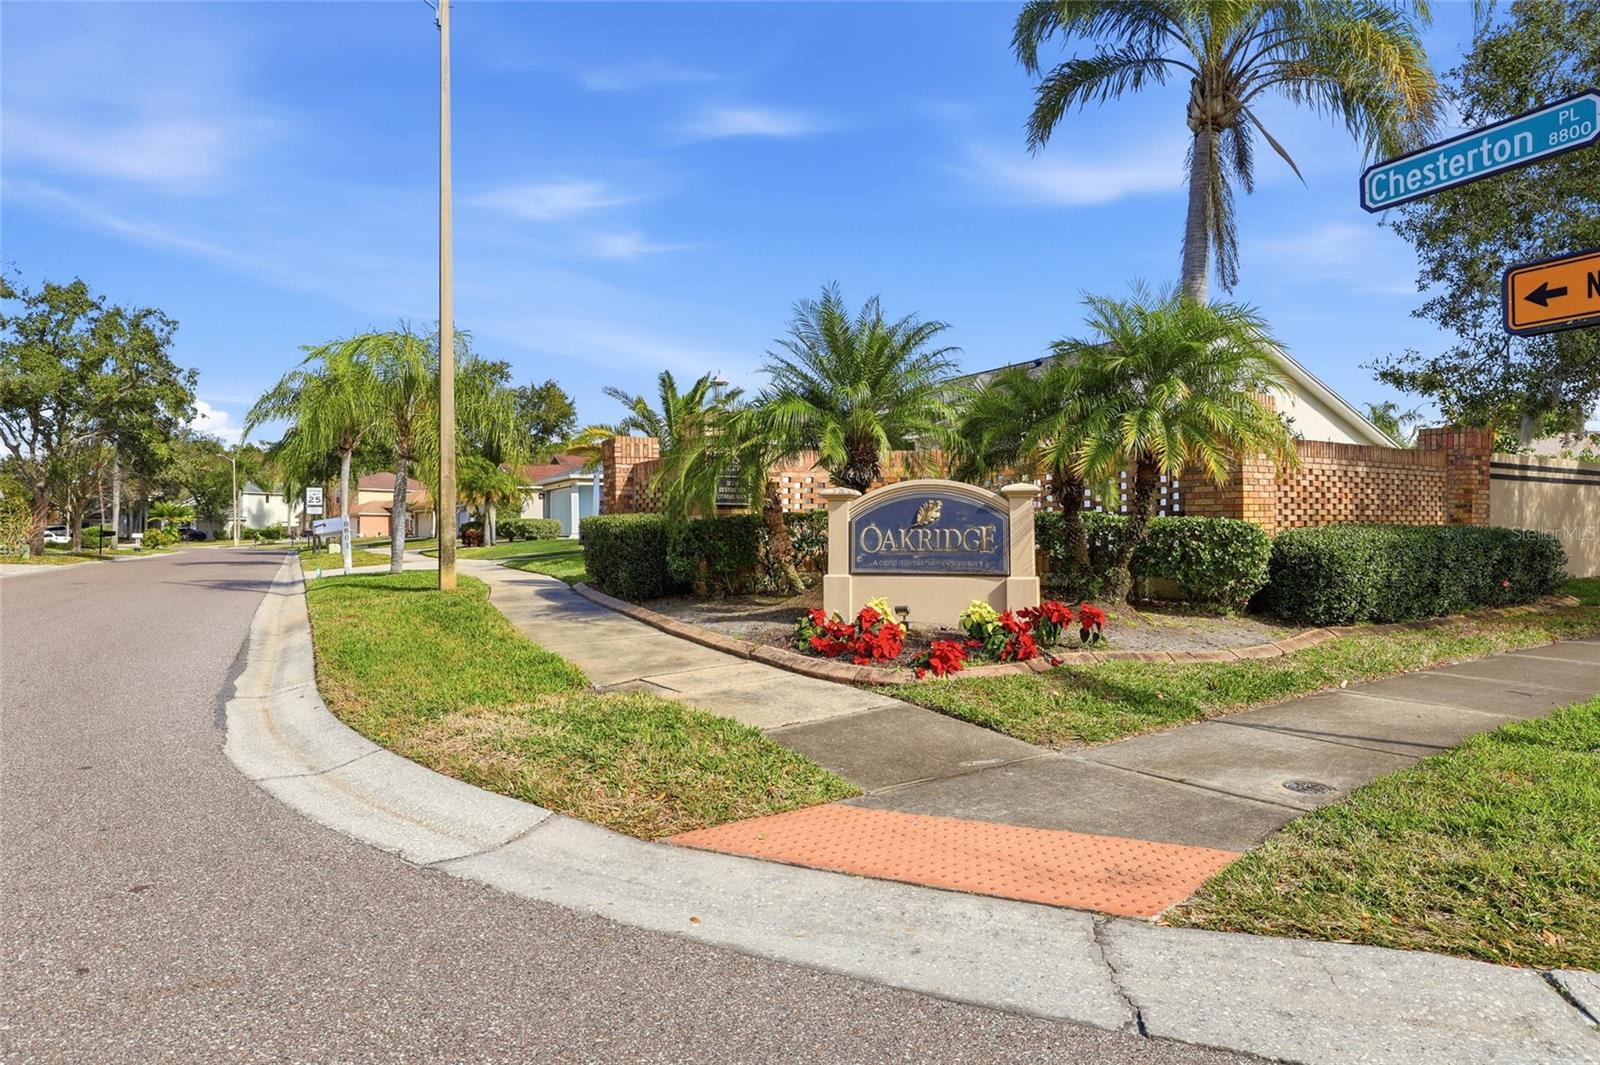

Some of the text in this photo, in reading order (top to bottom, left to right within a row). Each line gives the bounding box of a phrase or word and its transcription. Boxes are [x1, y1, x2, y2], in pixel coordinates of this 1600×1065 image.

[1558, 107, 1580, 126] PL
[1548, 120, 1592, 147] 8800
[1371, 130, 1534, 201] Chesterton
[859, 525, 998, 554] OAKRIDGE
